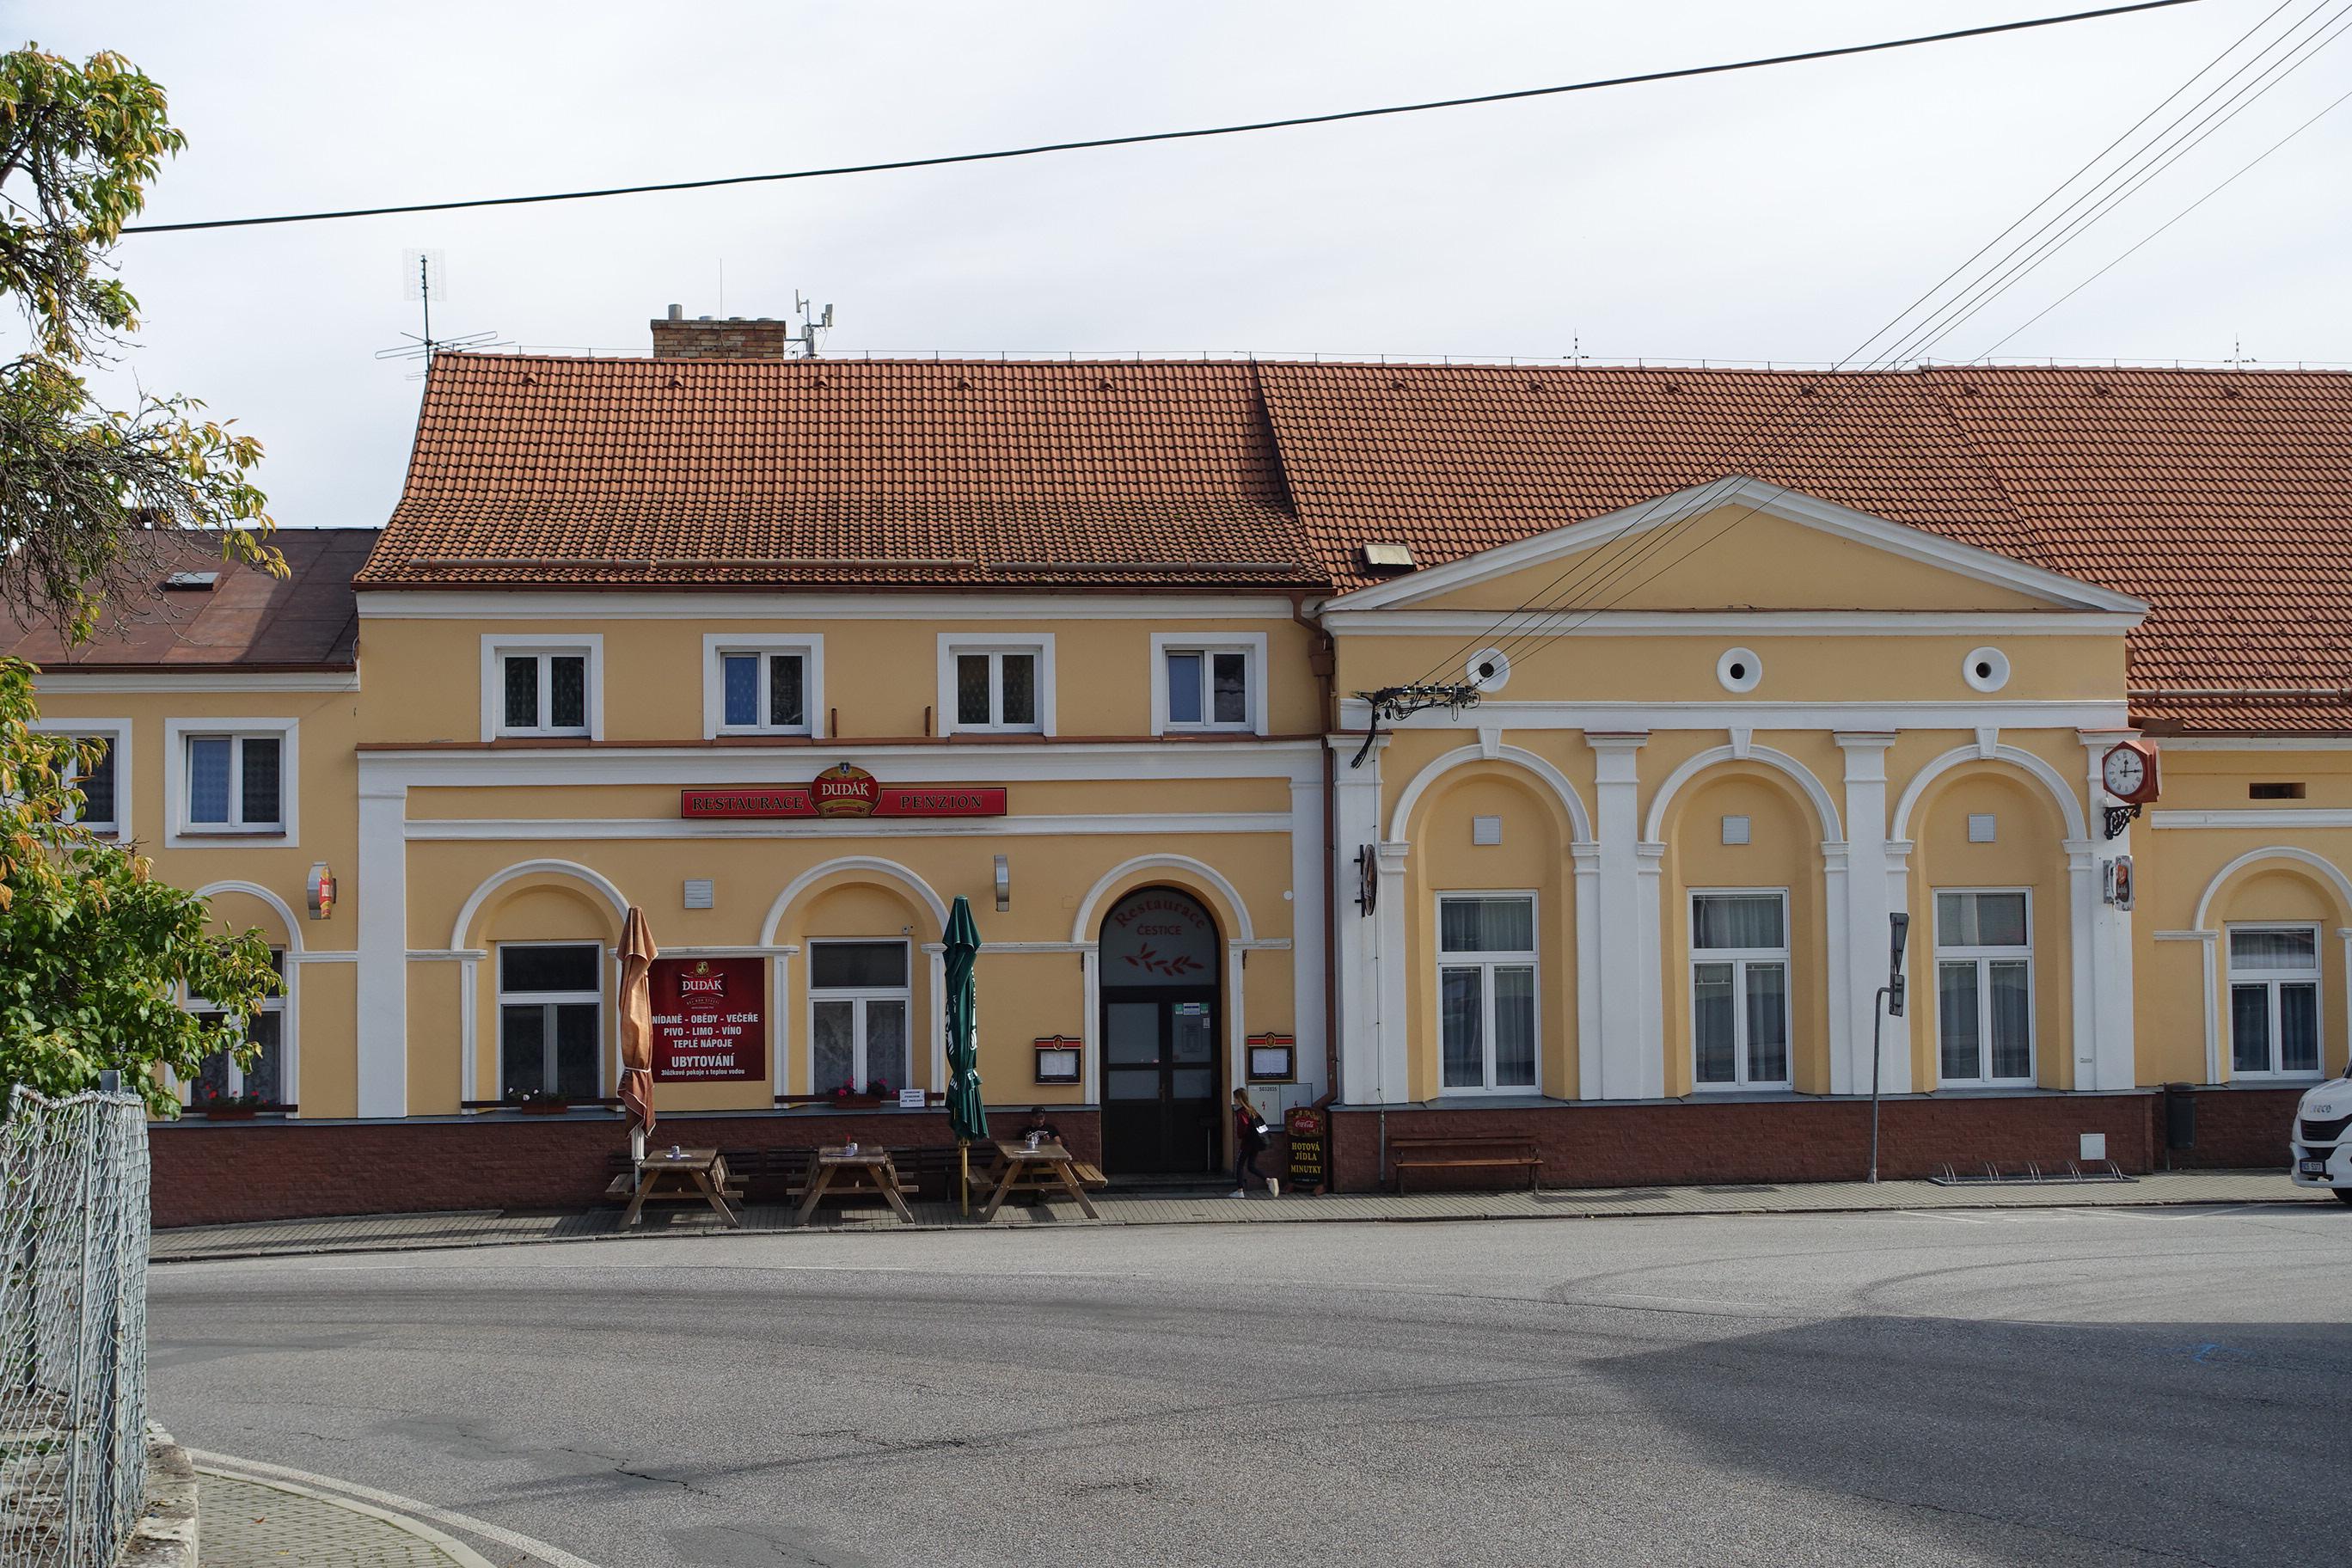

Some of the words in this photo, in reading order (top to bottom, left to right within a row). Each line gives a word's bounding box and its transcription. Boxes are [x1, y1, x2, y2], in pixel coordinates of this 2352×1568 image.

[821, 781, 870, 797] DUDÁK
[692, 796, 805, 811] RESTAURACE
[1114, 898, 1205, 929] Restaurace
[1136, 923, 1182, 935] ČESTICE
[682, 978, 723, 991] DUDÁK
[652, 1013, 683, 1024] NÍDANĚ
[690, 1013, 718, 1024] OBĚDY
[726, 1012, 759, 1023] VEČEŘE
[664, 1027, 683, 1036] PIVO
[692, 1027, 714, 1036] LIMO
[721, 1025, 742, 1035] VÍNO
[673, 1038, 698, 1048] TEPLÉ
[700, 1037, 732, 1048] NÁPOJE
[671, 1052, 735, 1068] UBYTOVÁNÍ
[1291, 1141, 1320, 1151] HOTOVÁ
[1295, 1152, 1317, 1161] JÍDLA
[1290, 1164, 1321, 1174] MINUTKY
